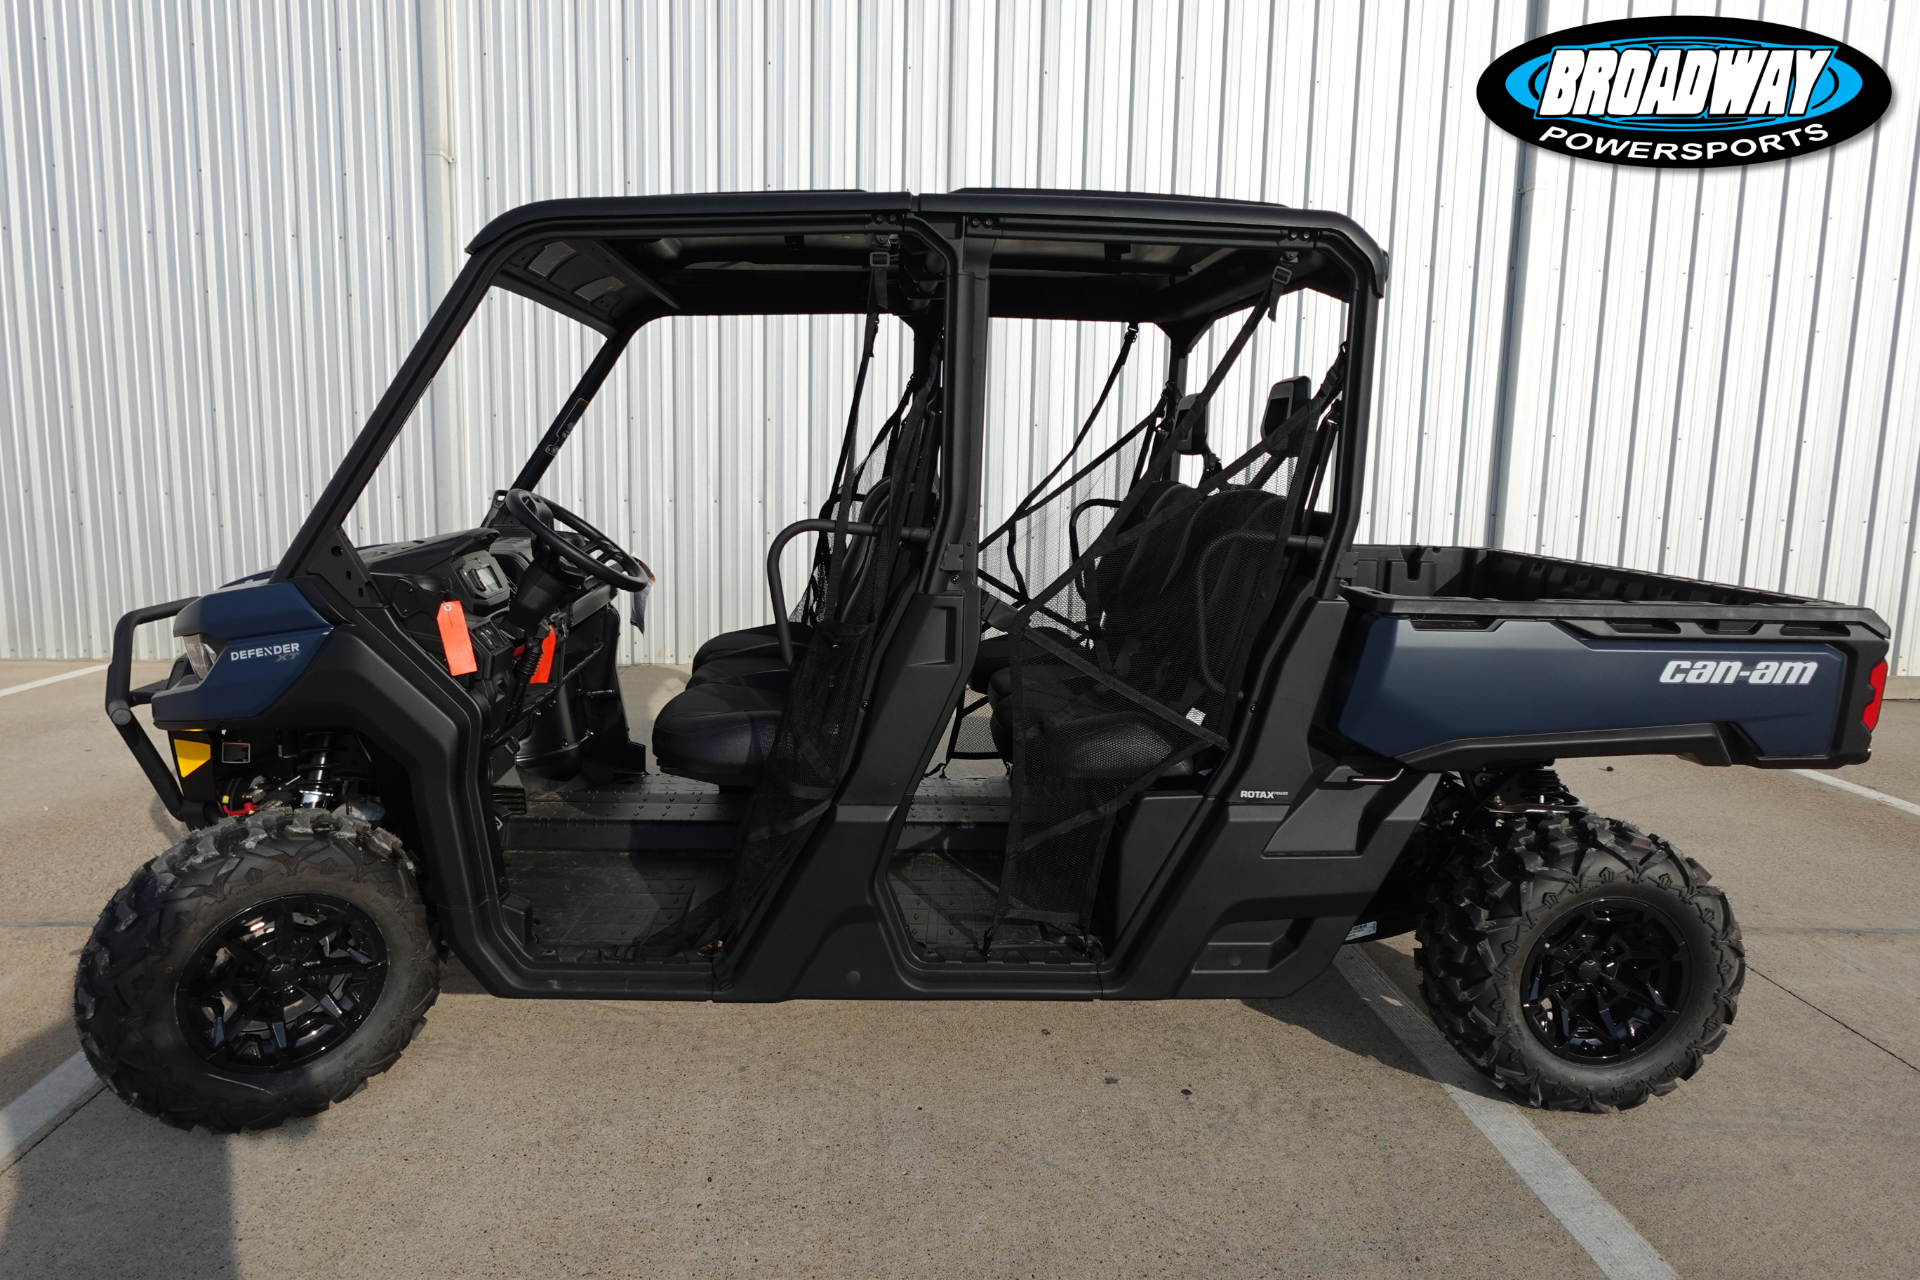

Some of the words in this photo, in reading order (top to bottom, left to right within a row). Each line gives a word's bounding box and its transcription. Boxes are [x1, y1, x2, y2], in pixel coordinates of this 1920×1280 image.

[230, 642, 300, 661] DEFENDER
[276, 652, 300, 662] XT
[1658, 660, 1819, 685] can-am
[1240, 790, 1274, 799] ROTAX
